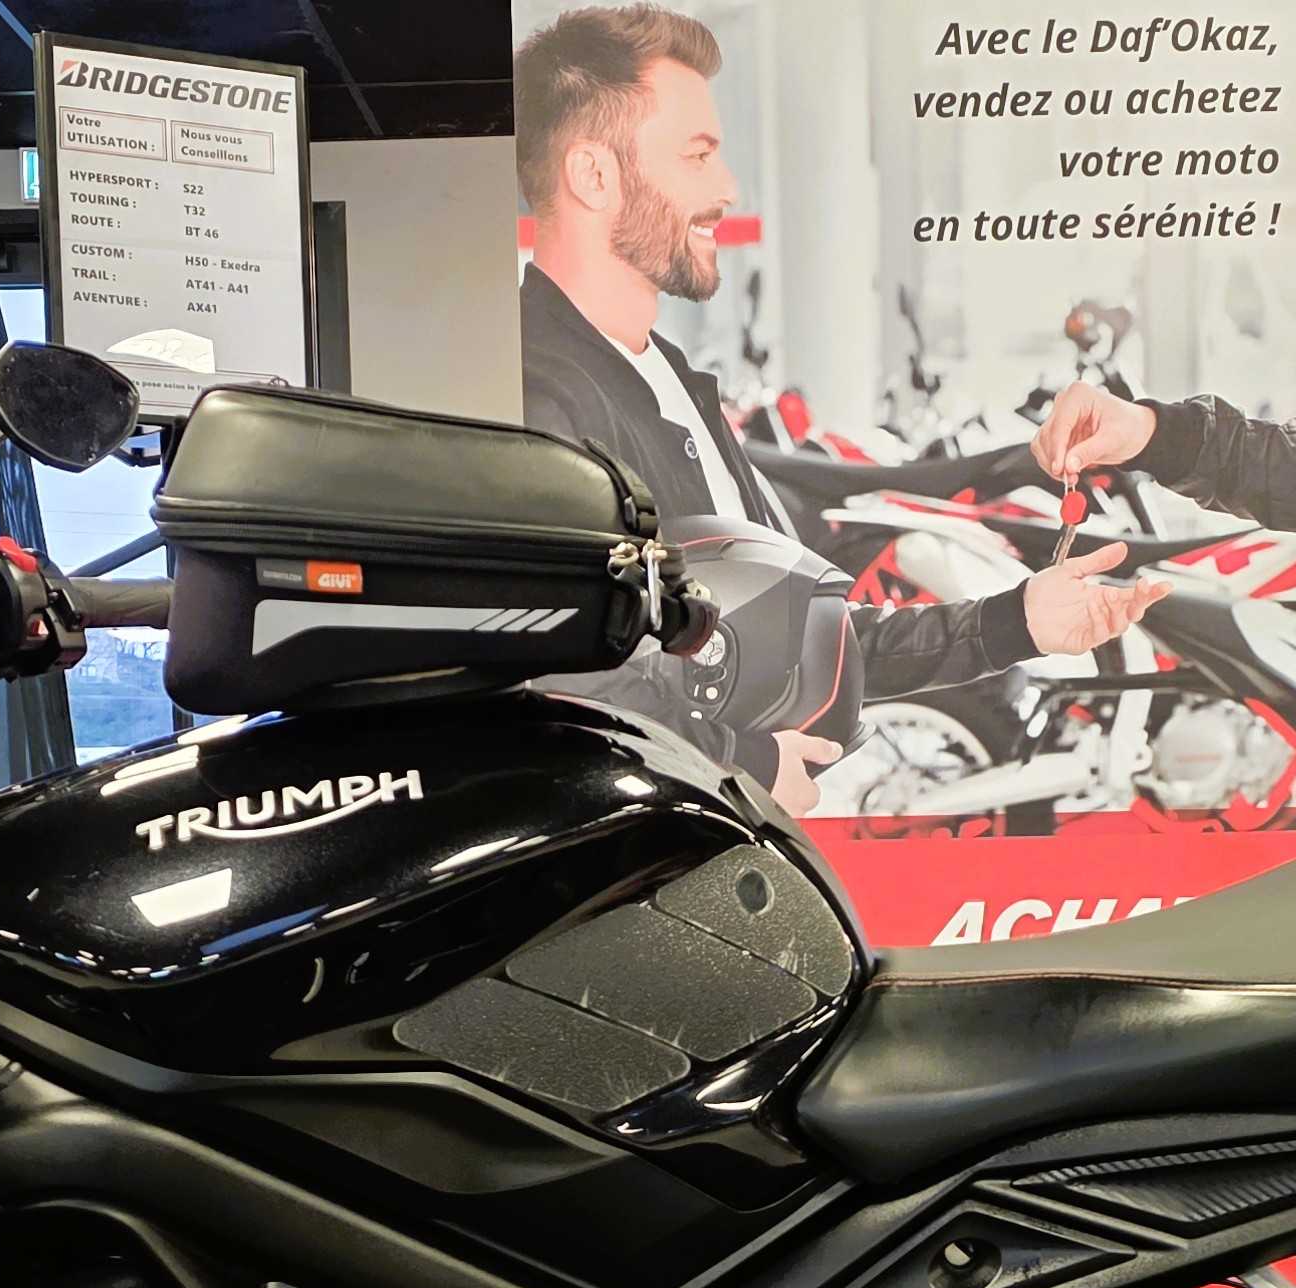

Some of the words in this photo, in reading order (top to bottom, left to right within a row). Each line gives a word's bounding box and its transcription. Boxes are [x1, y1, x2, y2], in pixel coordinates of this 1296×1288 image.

[935, 22, 1030, 56] Avec
[1042, 19, 1078, 54] le
[1090, 17, 1278, 62] Daf'Okaz,
[57, 60, 292, 114] BRIDGESTONE
[913, 83, 1052, 118] vendez
[1064, 89, 1113, 115] ou
[1126, 80, 1282, 114] achetez
[66, 115, 102, 128] Votre
[67, 132, 148, 151] UTILISATION
[180, 128, 212, 142] Nous
[215, 133, 243, 145] vous
[181, 146, 249, 163] Conseillons
[1060, 146, 1163, 178] votre
[1175, 144, 1279, 176] moto
[69, 171, 152, 190] HYPERSPORT
[183, 184, 204, 195] S22
[70, 192, 130, 208] TOURING
[184, 205, 206, 216] T32
[71, 215, 115, 229] ROUTE
[185, 226, 201, 238] BT
[204, 228, 220, 240] 46
[913, 214, 960, 242] en
[974, 209, 1081, 241] toute
[1092, 201, 1256, 240] sérénité
[71, 244, 126, 260] CUSTOM
[185, 255, 209, 268] H50
[220, 260, 261, 273] Exedra
[72, 267, 110, 281] TRAIL
[185, 279, 216, 291] AT41
[227, 282, 250, 294] A41
[73, 292, 142, 307] AVENTURE
[187, 301, 218, 314] AX41
[318, 573, 353, 589] GIVI
[136, 770, 424, 850] TRIUMPH
